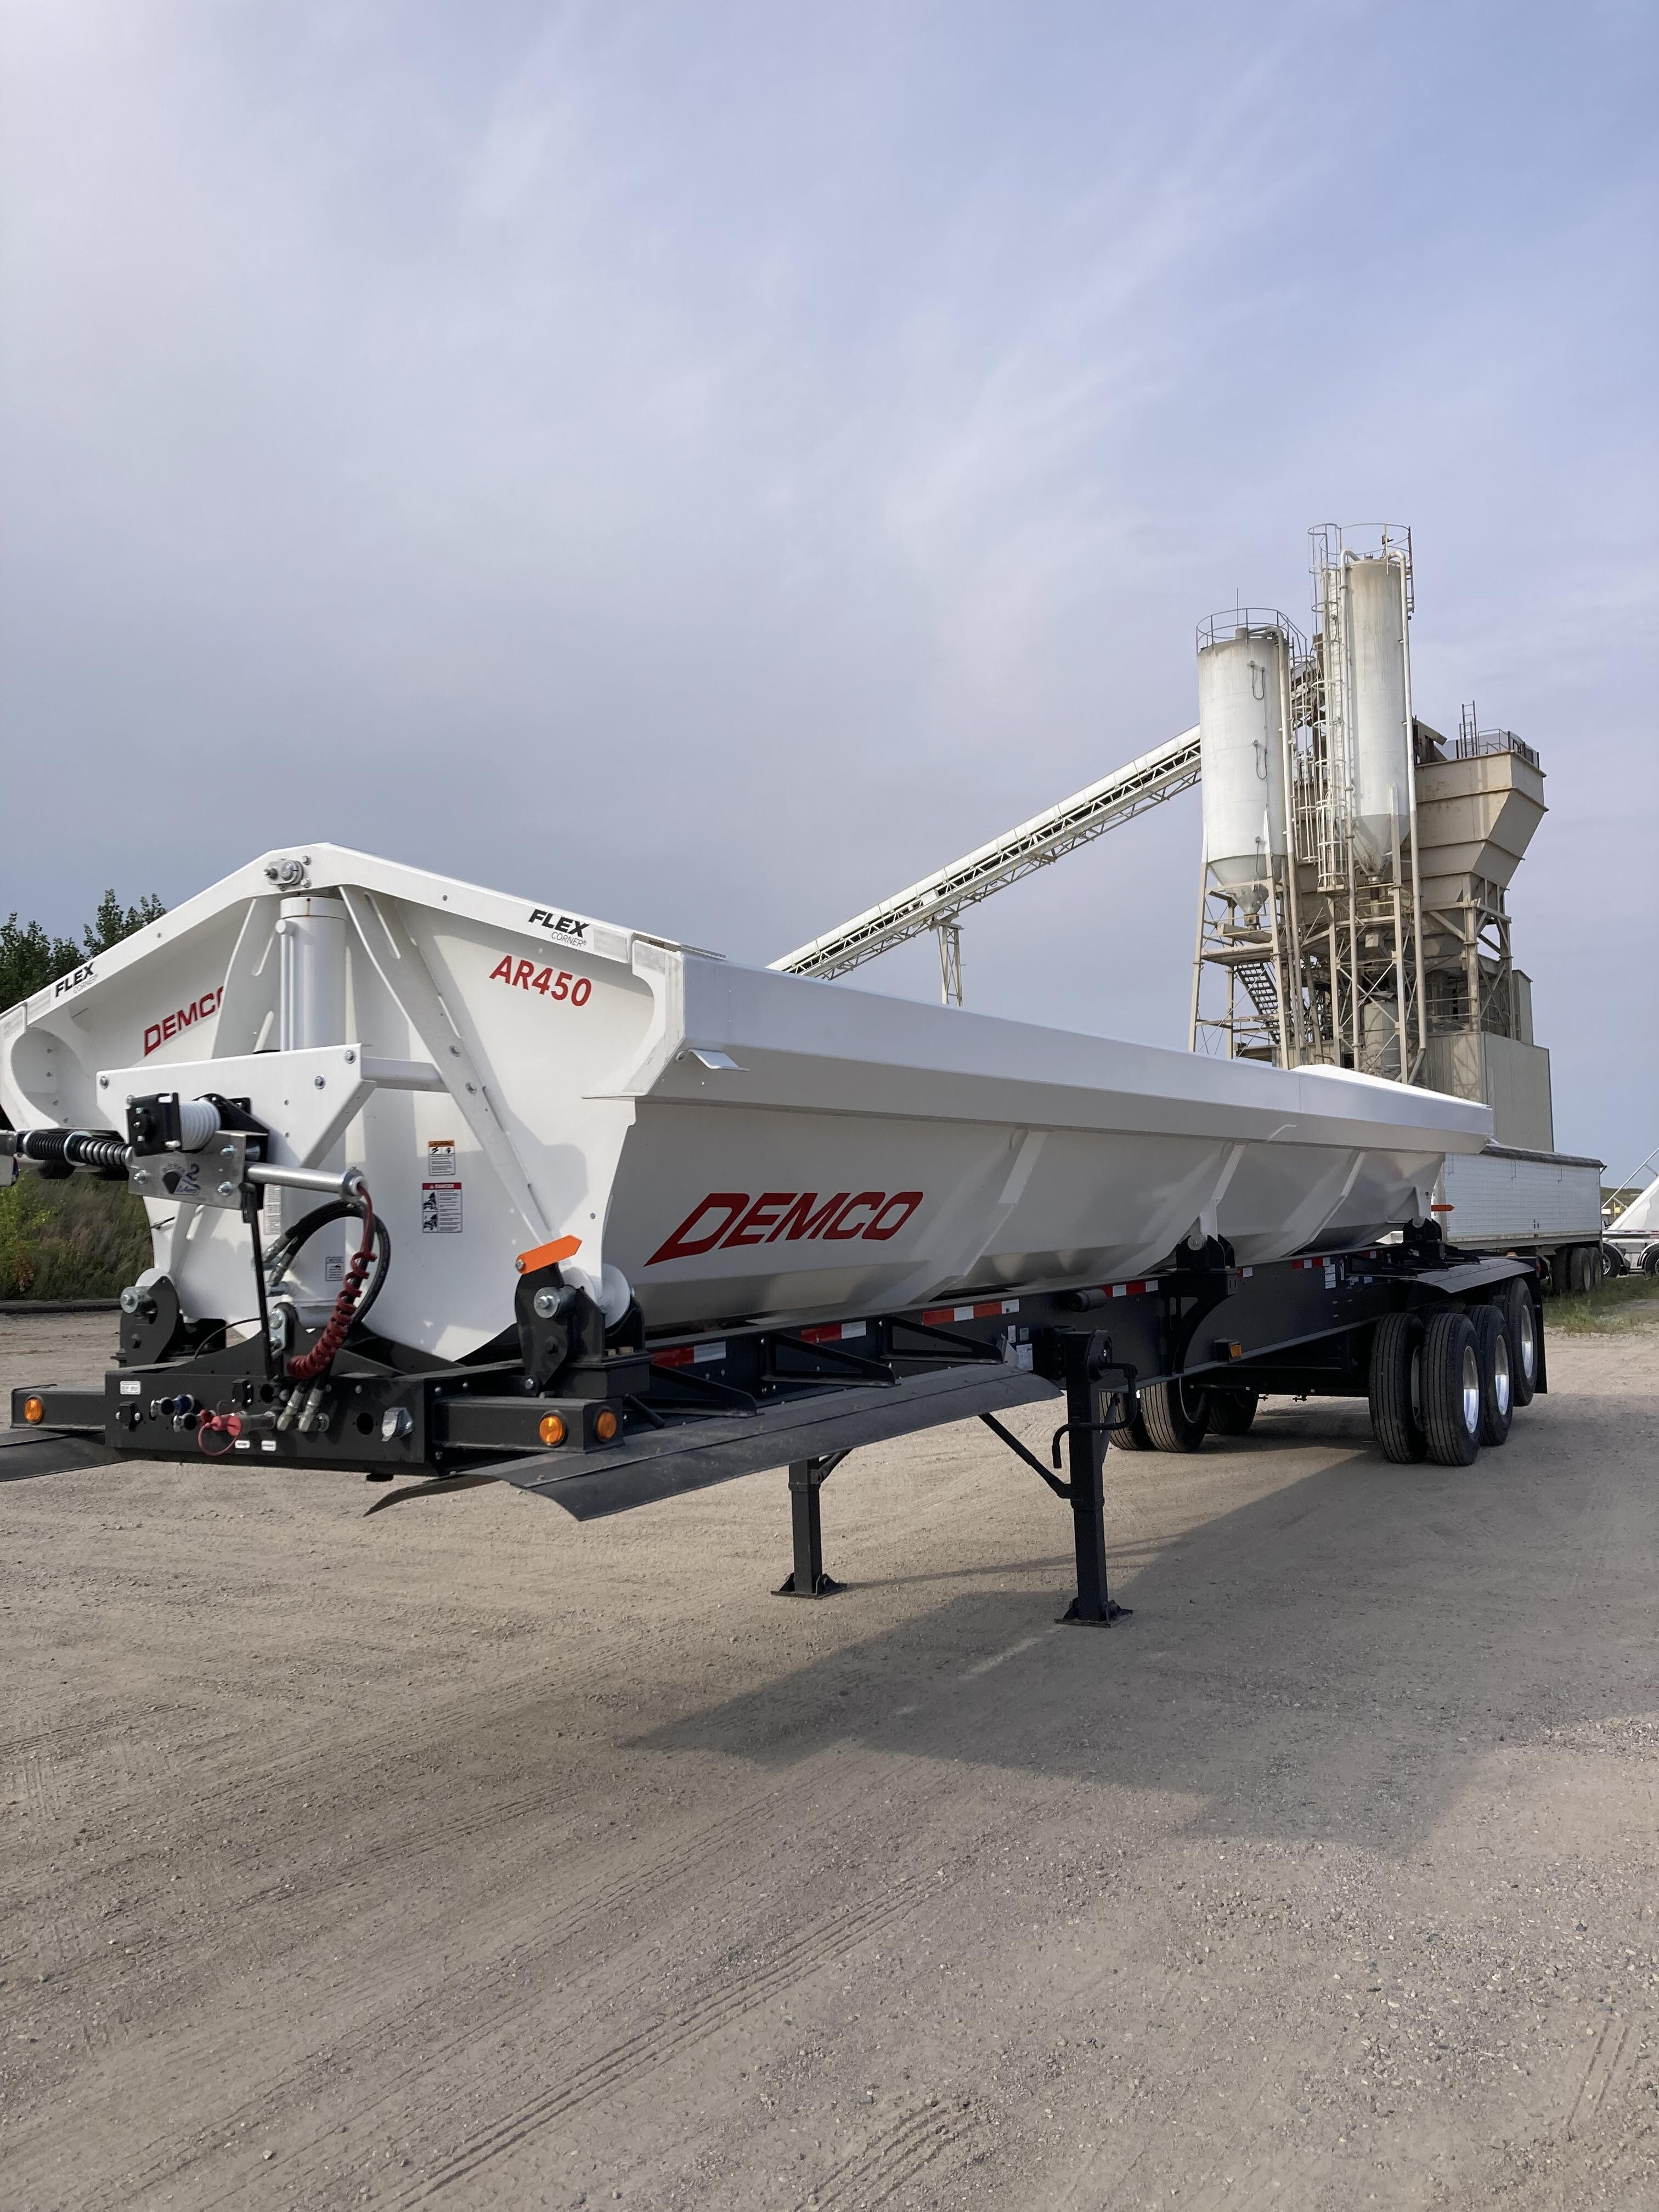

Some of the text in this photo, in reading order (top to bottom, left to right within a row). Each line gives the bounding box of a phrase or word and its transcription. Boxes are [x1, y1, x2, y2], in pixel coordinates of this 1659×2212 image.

[528, 909, 590, 938] FLEX
[55, 961, 94, 998] FLEX
[489, 955, 592, 1007] AR450
[643, 1191, 924, 1267] DEMCO
